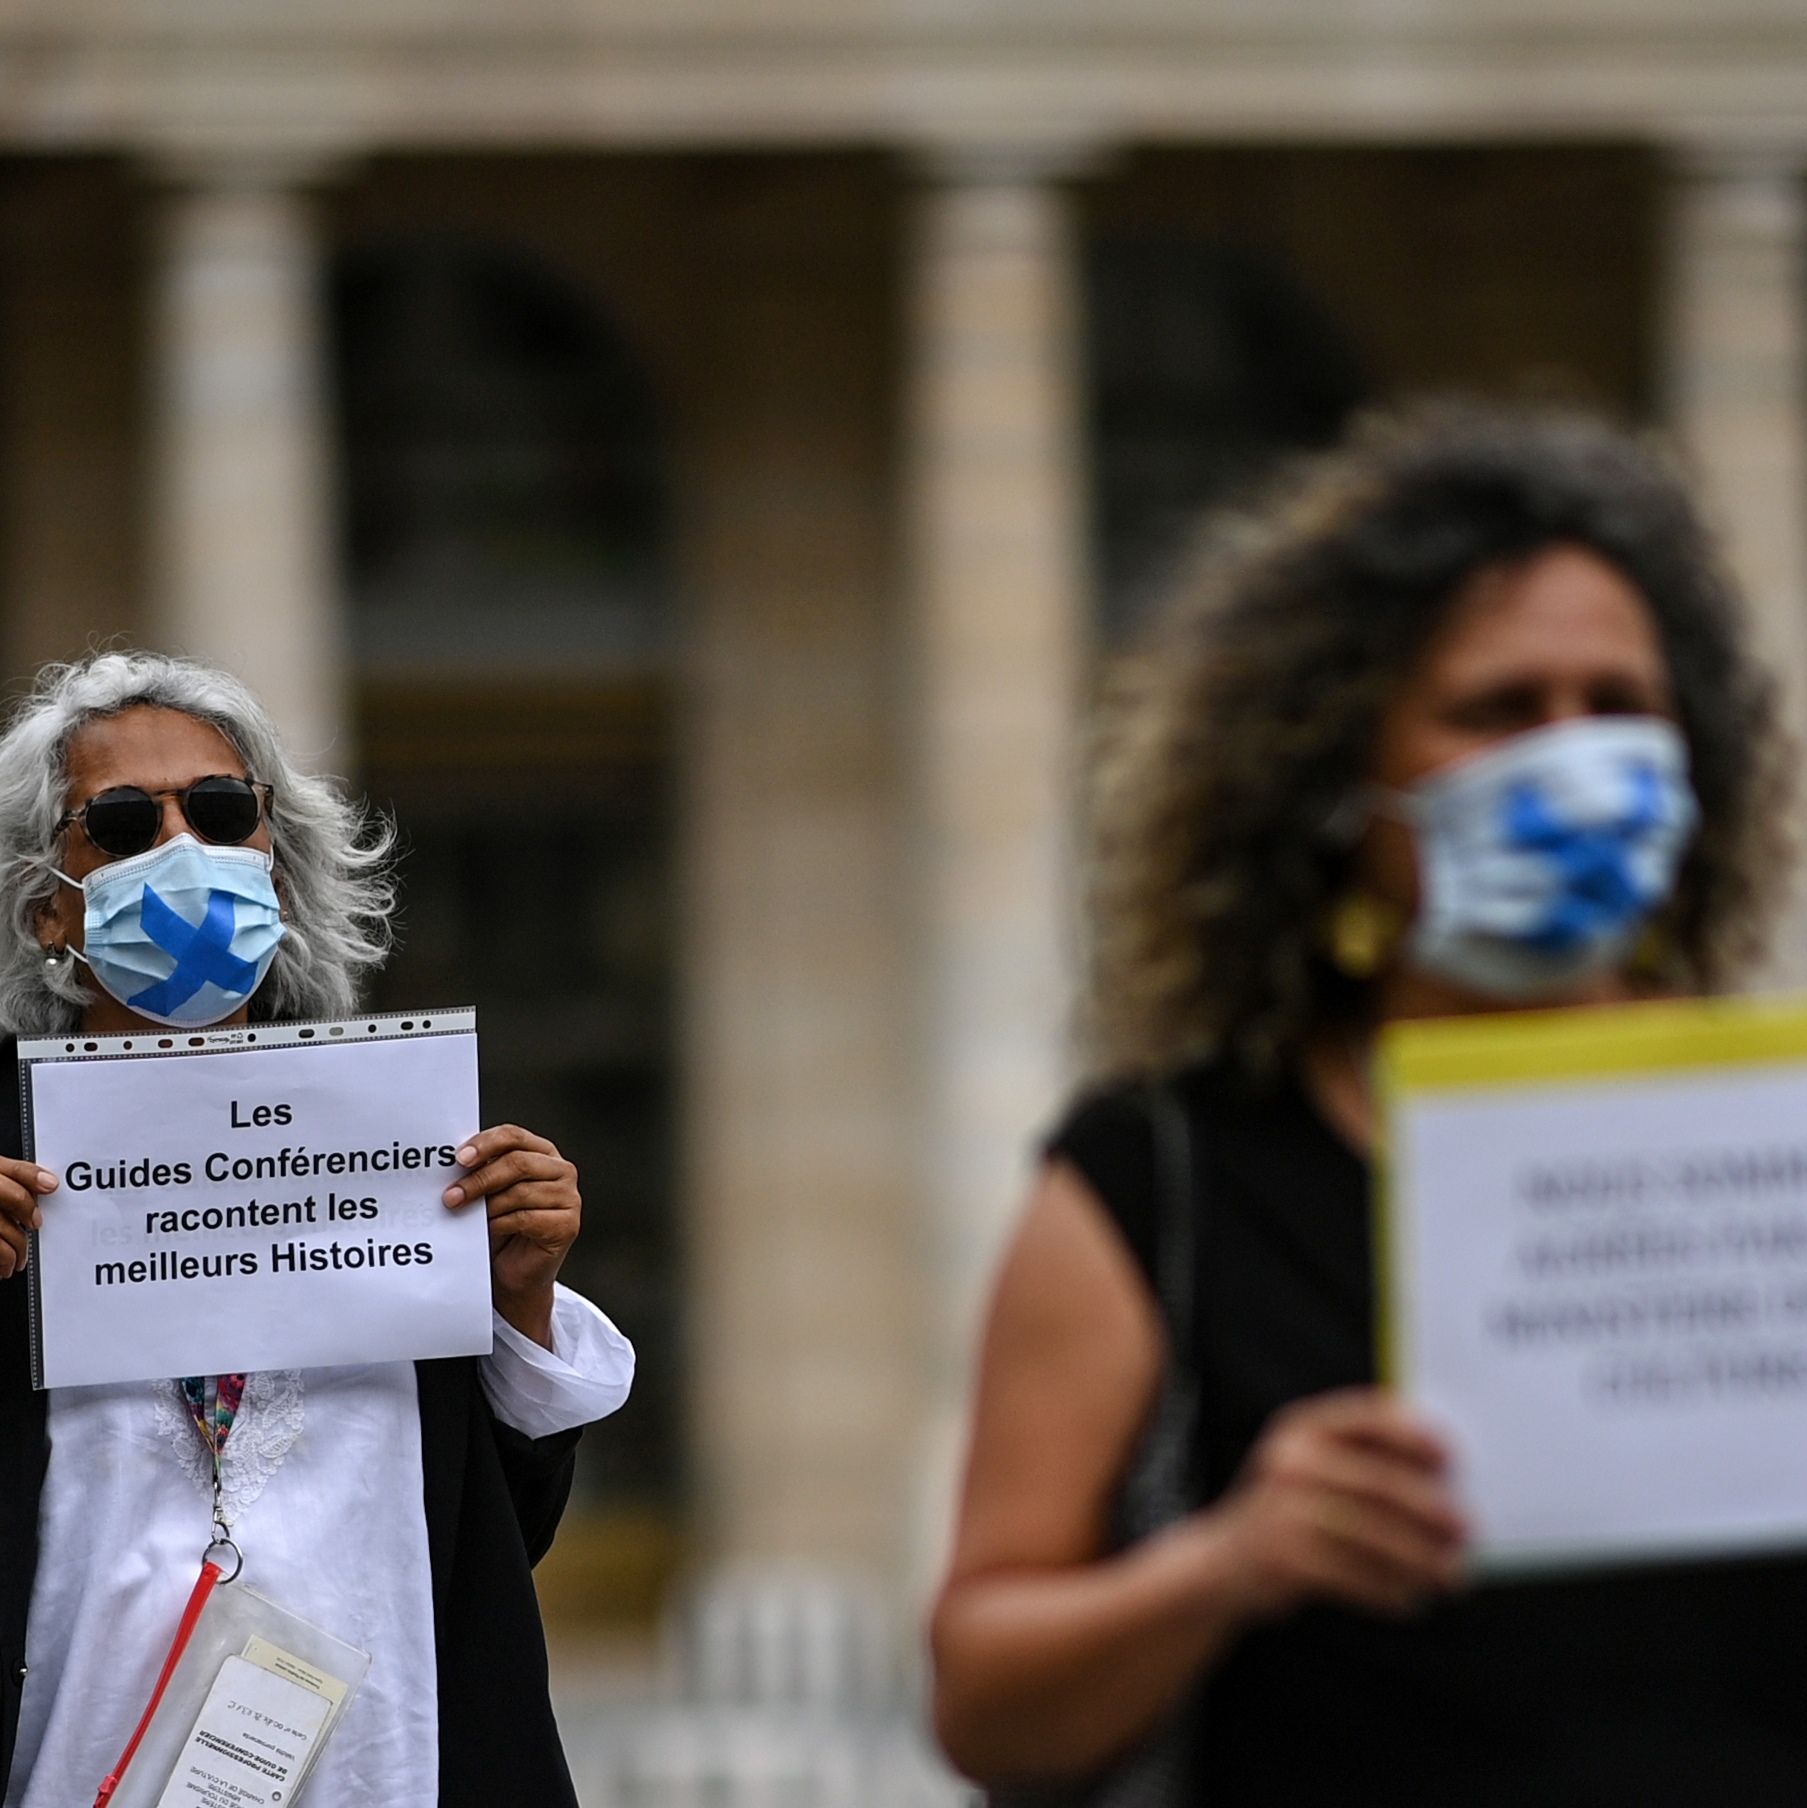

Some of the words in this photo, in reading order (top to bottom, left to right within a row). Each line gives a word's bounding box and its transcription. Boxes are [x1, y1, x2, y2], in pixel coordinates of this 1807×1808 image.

[230, 1099, 293, 1129] Les
[65, 1157, 193, 1191] Guides
[205, 1141, 456, 1182] Conférenciers
[145, 1194, 317, 1235] racontent
[328, 1192, 379, 1221] les
[95, 1249, 258, 1286] meilleurs
[271, 1238, 434, 1273] Histoires
